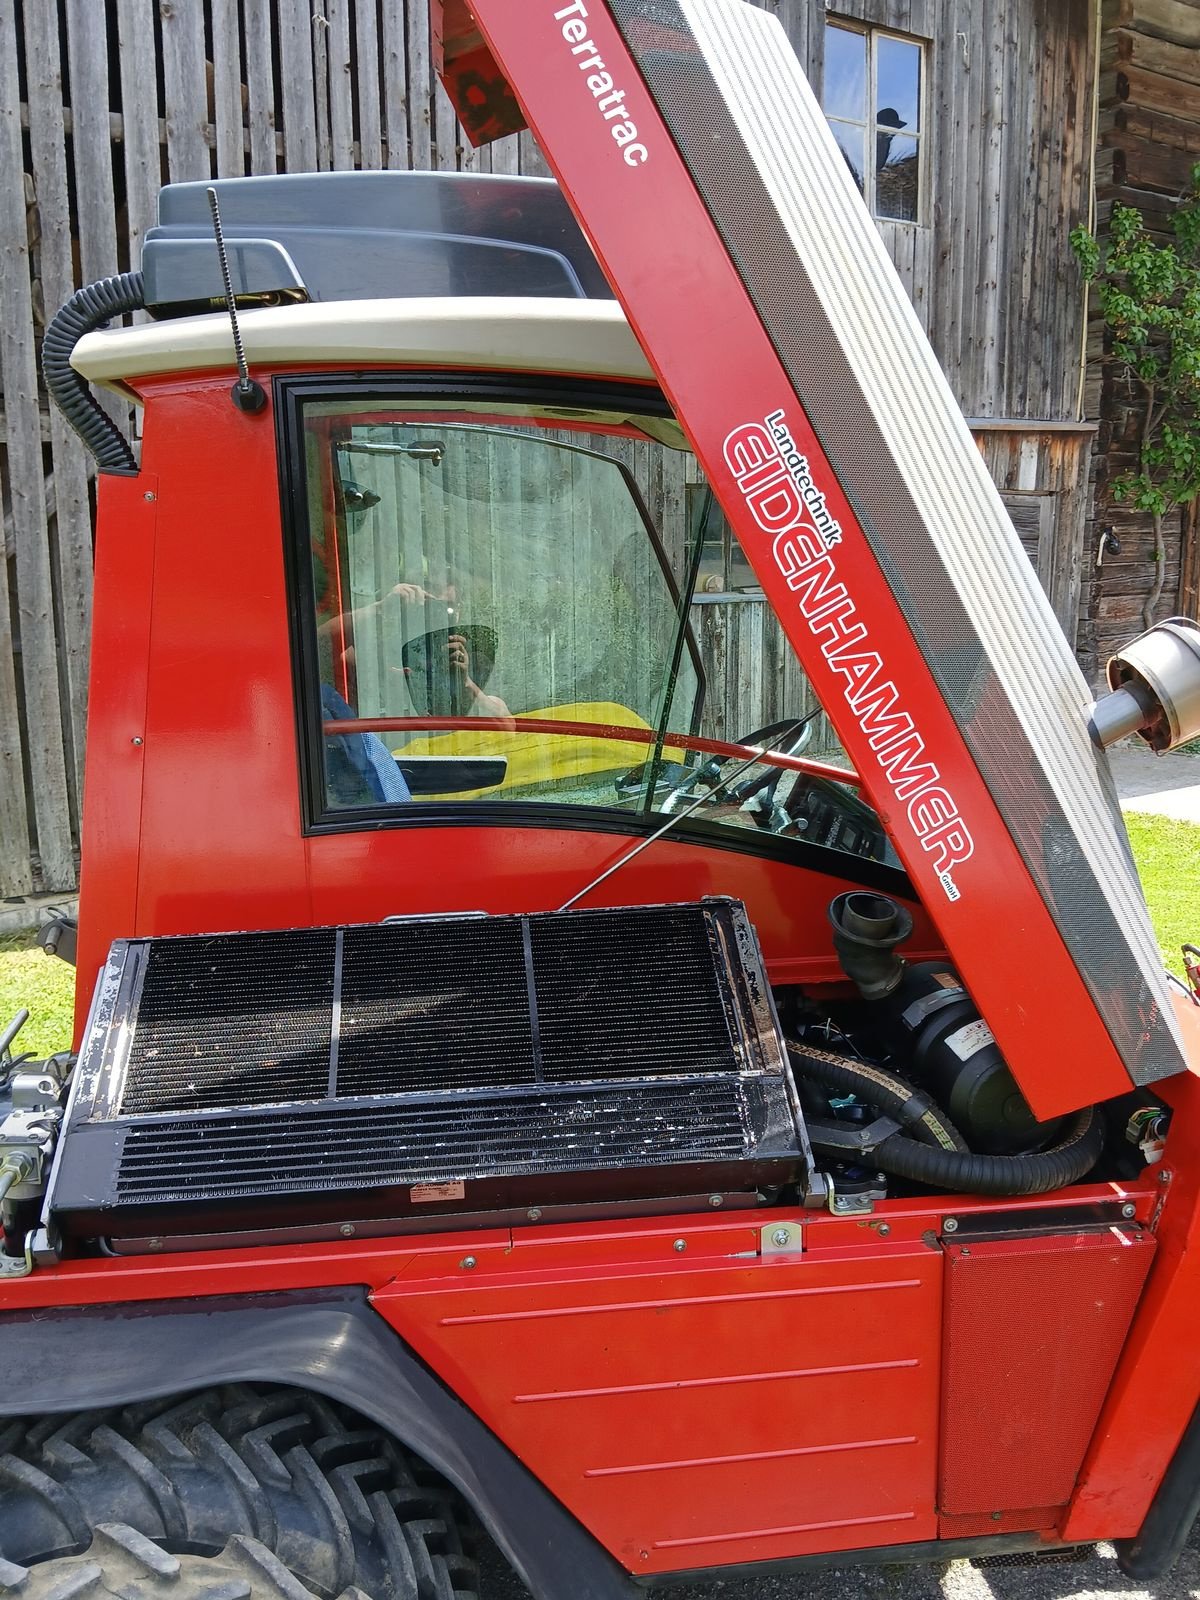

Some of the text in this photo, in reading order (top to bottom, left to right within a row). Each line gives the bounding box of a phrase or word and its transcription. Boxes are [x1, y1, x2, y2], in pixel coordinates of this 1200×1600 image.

[554, 0, 649, 167] Terratrac
[765, 409, 844, 549] Landtechnik
[722, 422, 975, 876] EIDENHAMMER
[940, 873, 959, 900] GmbH
